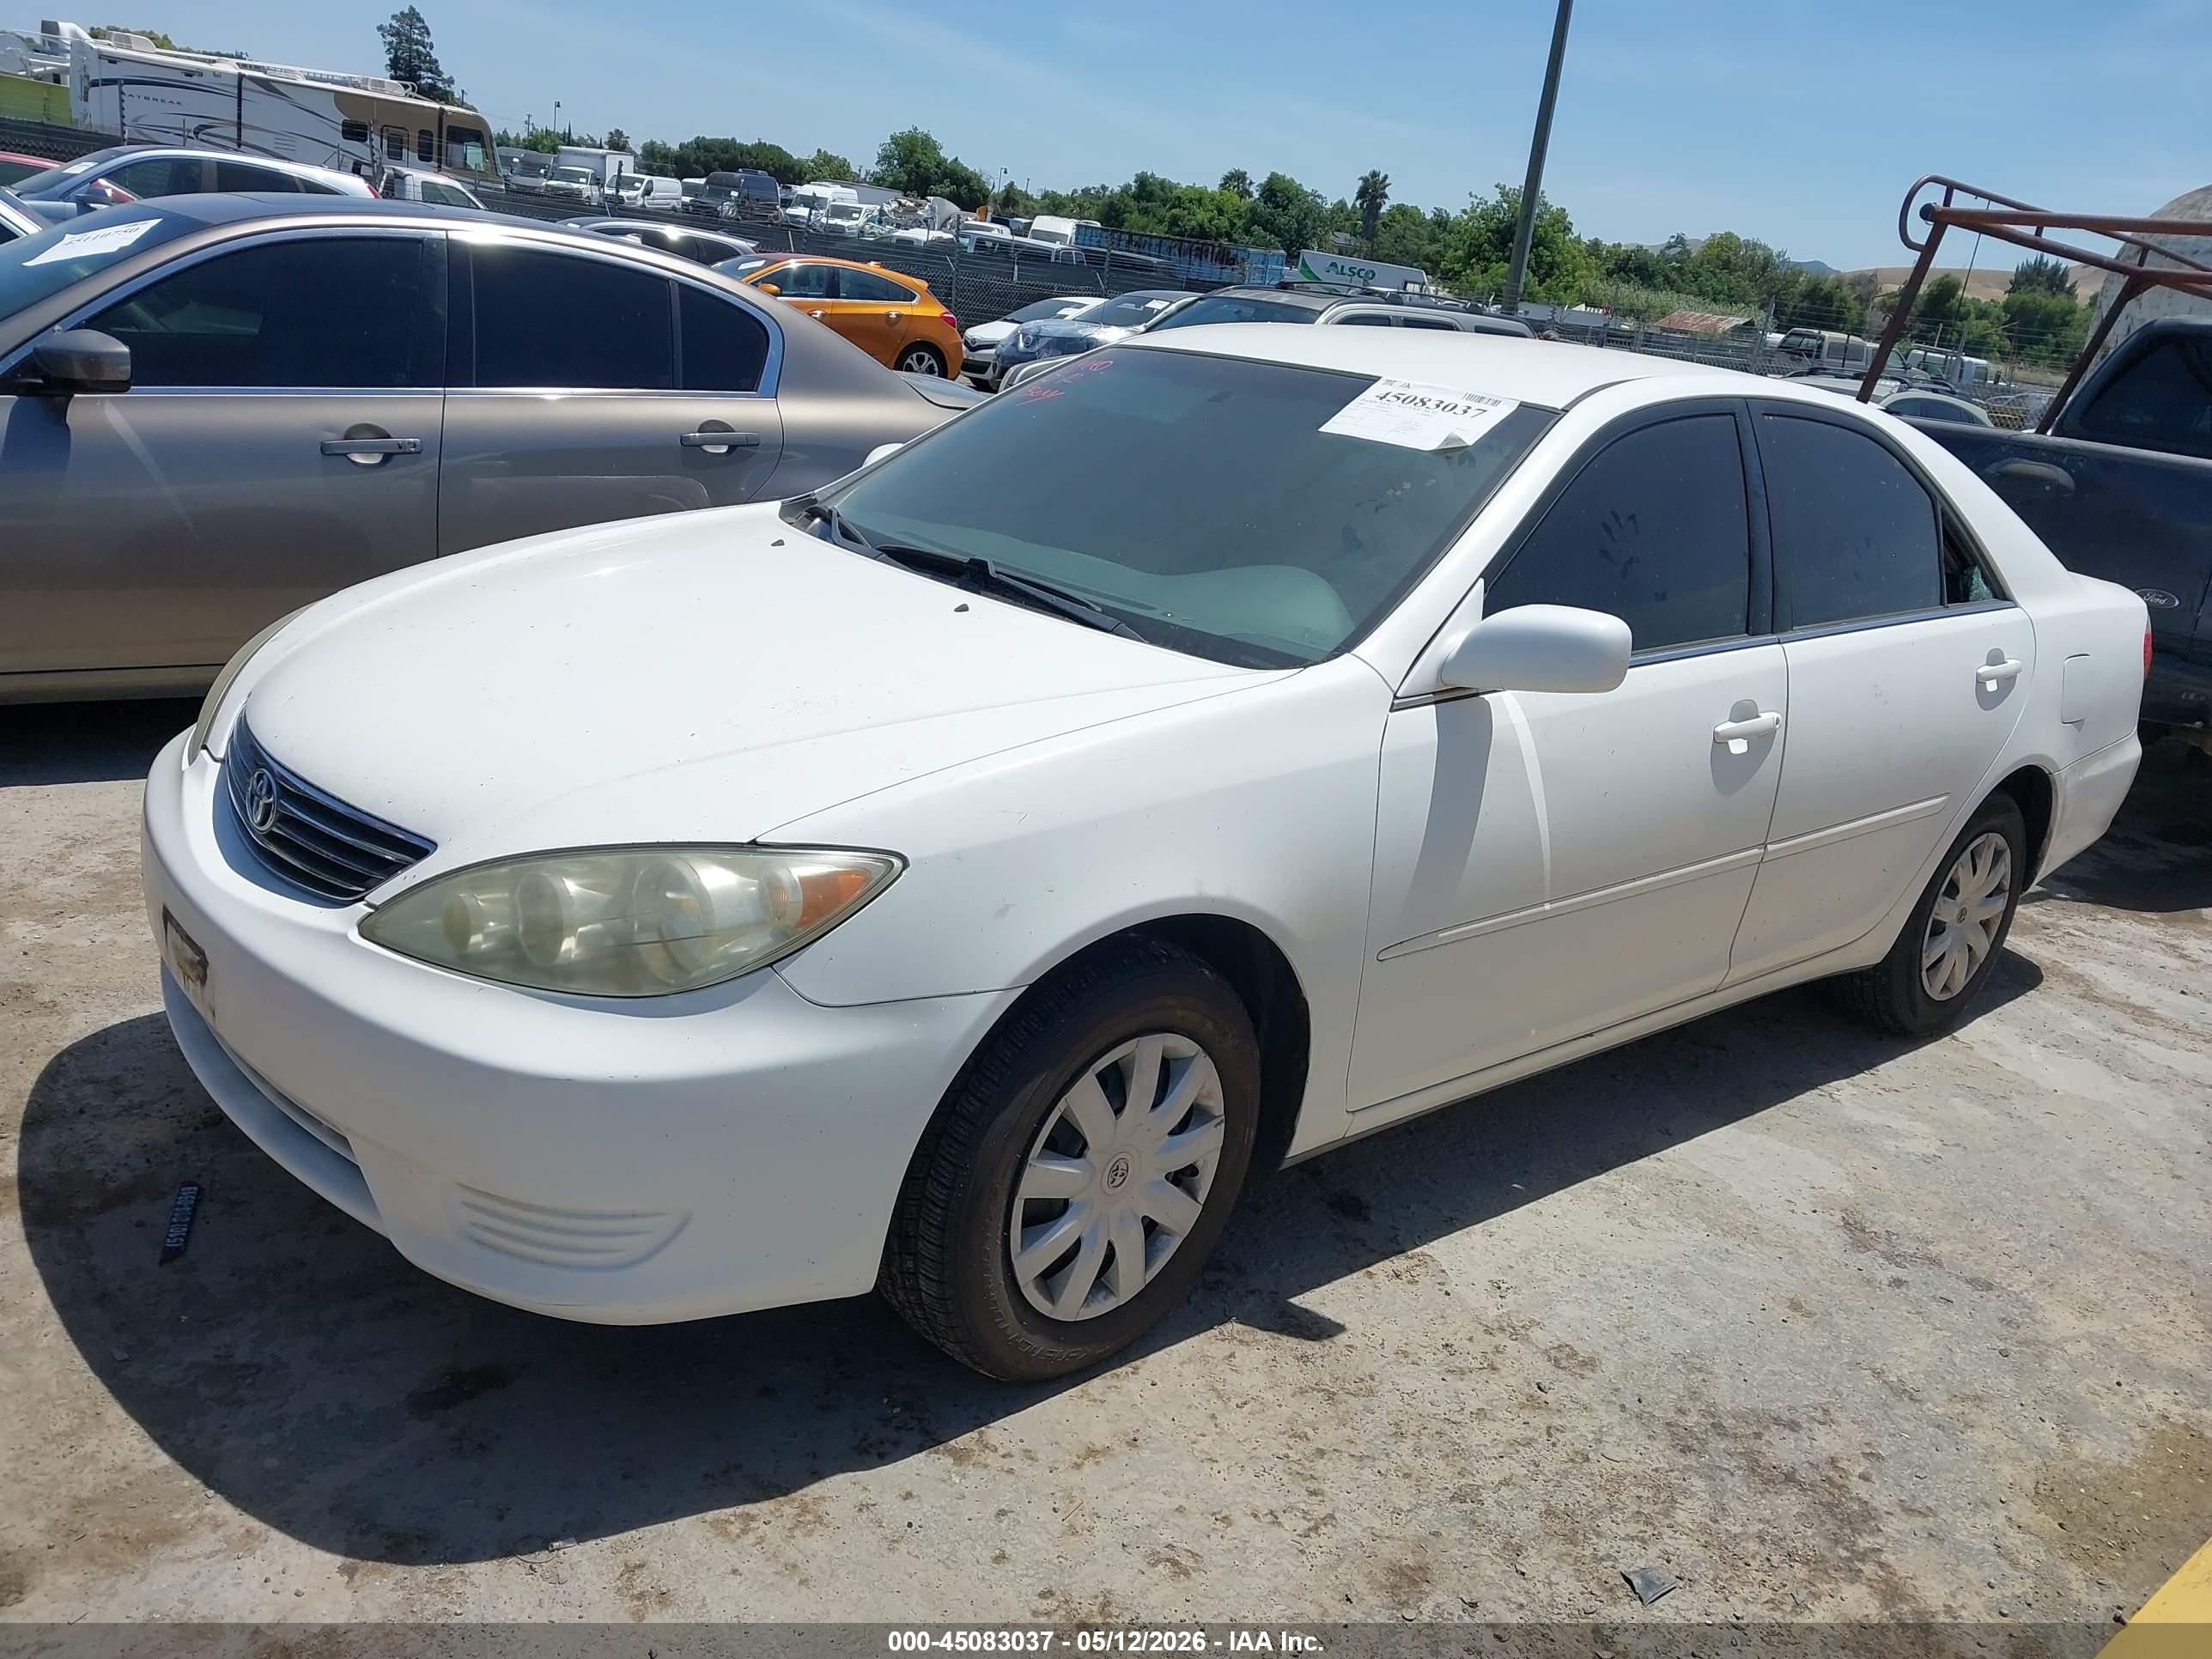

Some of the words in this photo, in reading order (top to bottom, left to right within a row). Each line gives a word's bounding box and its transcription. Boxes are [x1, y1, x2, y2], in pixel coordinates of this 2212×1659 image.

[123, 90, 183, 106] AYBREAK
[1325, 261, 1376, 281] ALSCO
[1374, 390, 1491, 418] 45083037
[2143, 592, 2168, 605] Ford
